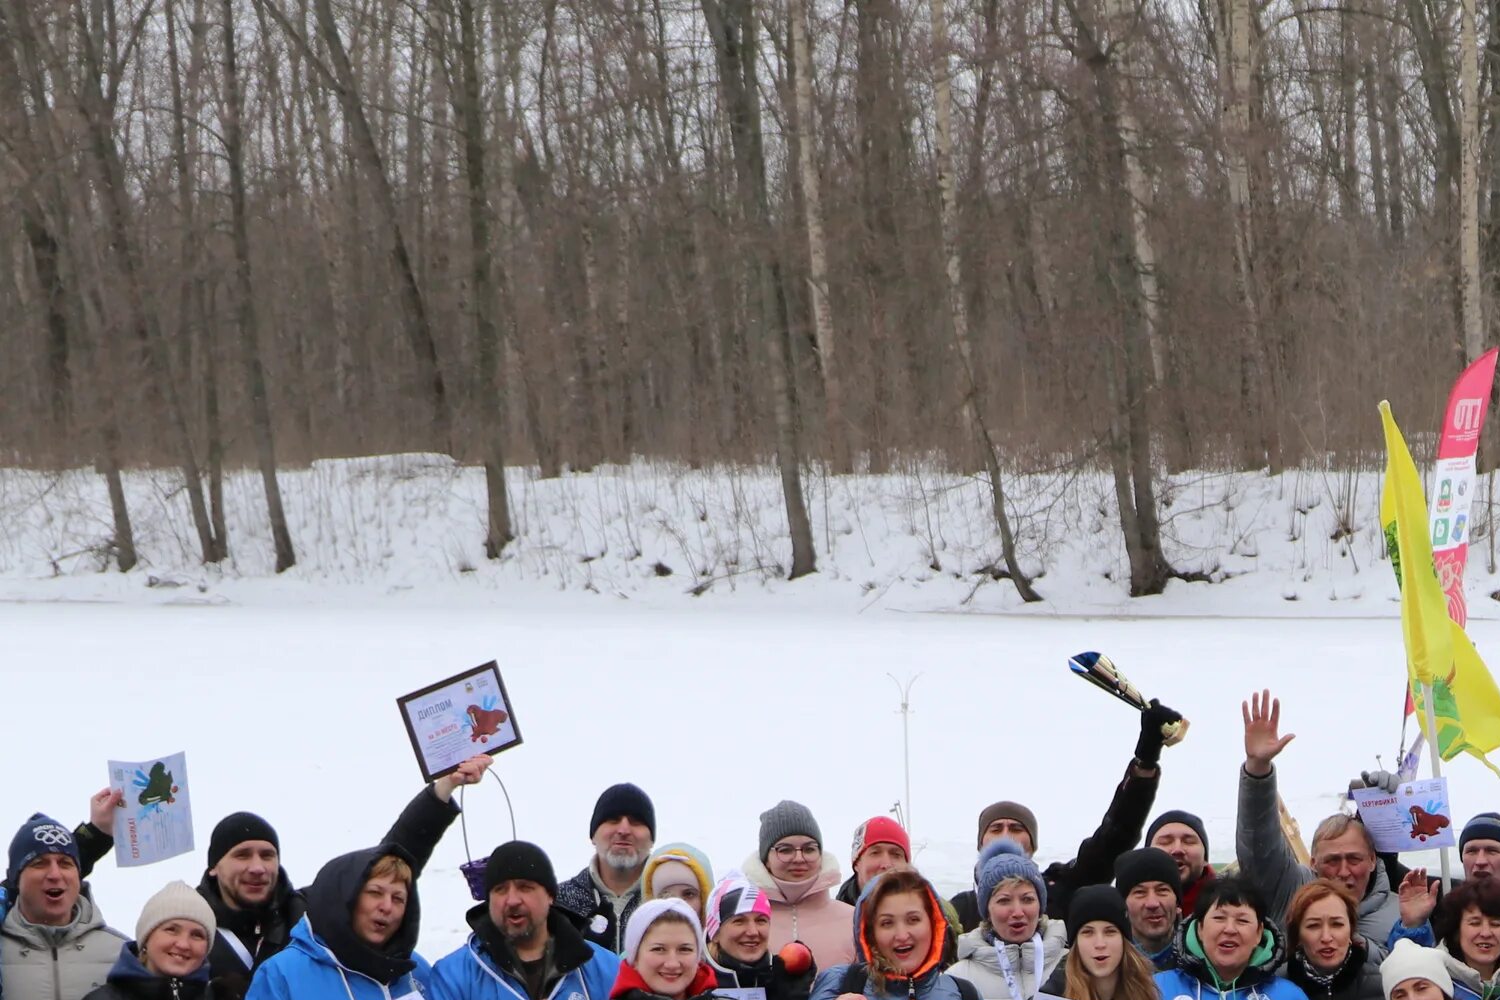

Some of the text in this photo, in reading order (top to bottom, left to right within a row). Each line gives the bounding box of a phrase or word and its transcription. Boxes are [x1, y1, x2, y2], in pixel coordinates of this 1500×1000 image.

[418, 699, 454, 721] ДИПЛОМ
[1361, 797, 1398, 808] СЕРТИФИКАТ
[127, 818, 140, 859] СЕРТИФИКАТ
